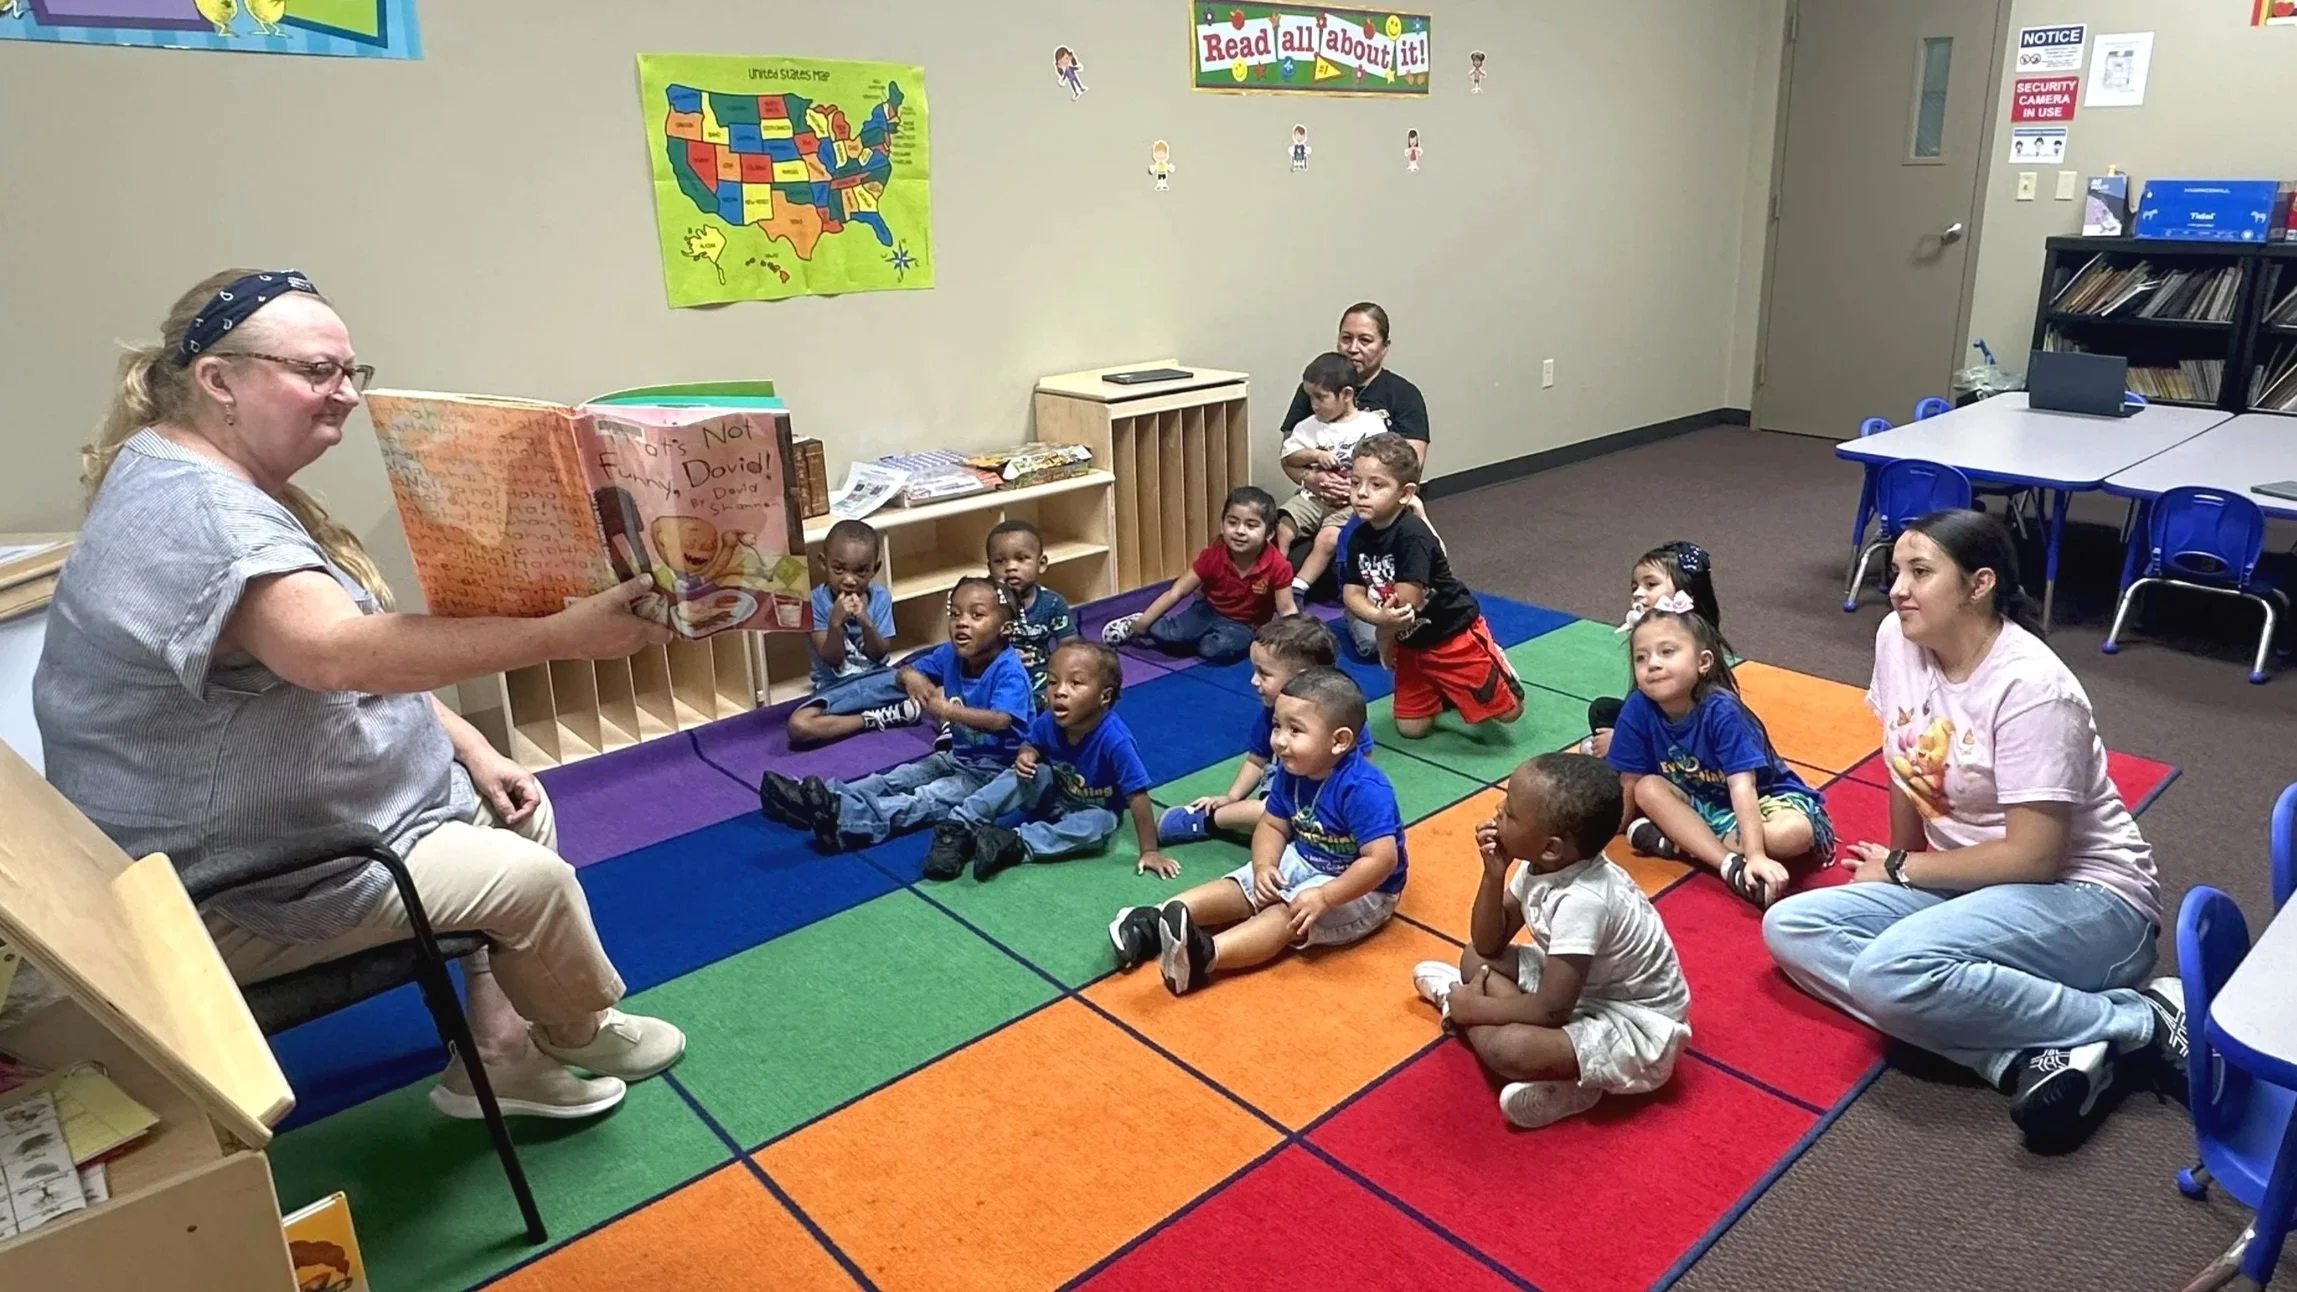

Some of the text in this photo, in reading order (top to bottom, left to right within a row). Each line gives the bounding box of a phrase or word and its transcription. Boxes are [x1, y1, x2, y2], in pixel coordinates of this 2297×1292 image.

[2023, 29, 2081, 45] NOTICE
[1203, 26, 1426, 69] Read all about it!
[747, 68, 831, 82] United States Map
[2017, 80, 2077, 93] SECURITY
[2018, 94, 2071, 106] CAMERA
[2023, 106, 2063, 118] IN USE
[702, 417, 753, 450] Not
[598, 451, 773, 501] Funny, David!
[712, 483, 758, 501] David
